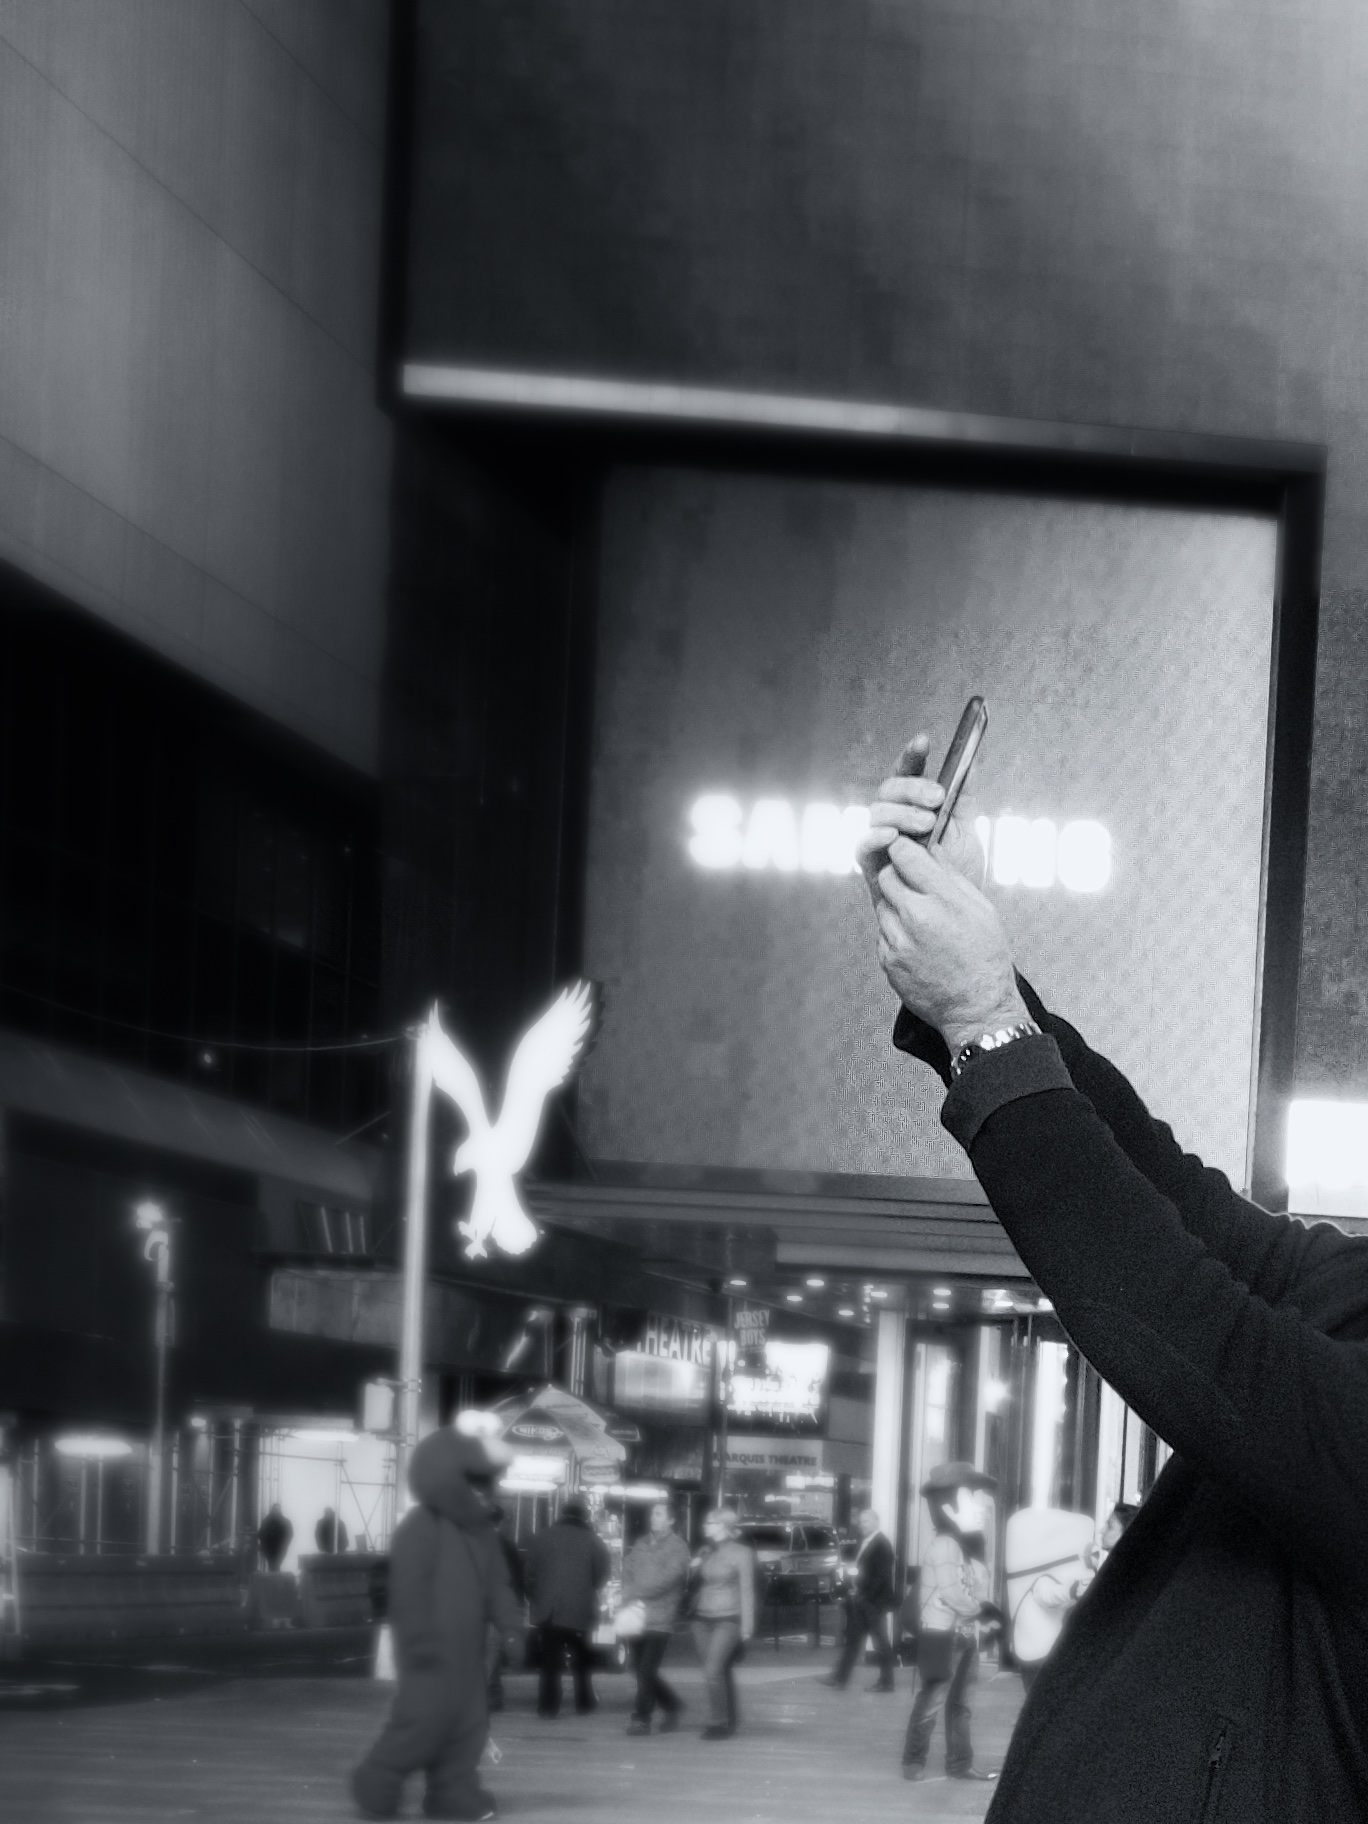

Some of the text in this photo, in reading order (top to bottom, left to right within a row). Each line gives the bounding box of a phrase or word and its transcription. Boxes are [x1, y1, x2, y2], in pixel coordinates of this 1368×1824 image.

[689, 793, 1112, 892] SAMNG
[734, 1309, 770, 1329] JERSEY
[636, 1313, 712, 1367] HEATRE
[740, 1328, 766, 1346] BOYS
[769, 1454, 818, 1466] THEATRE
